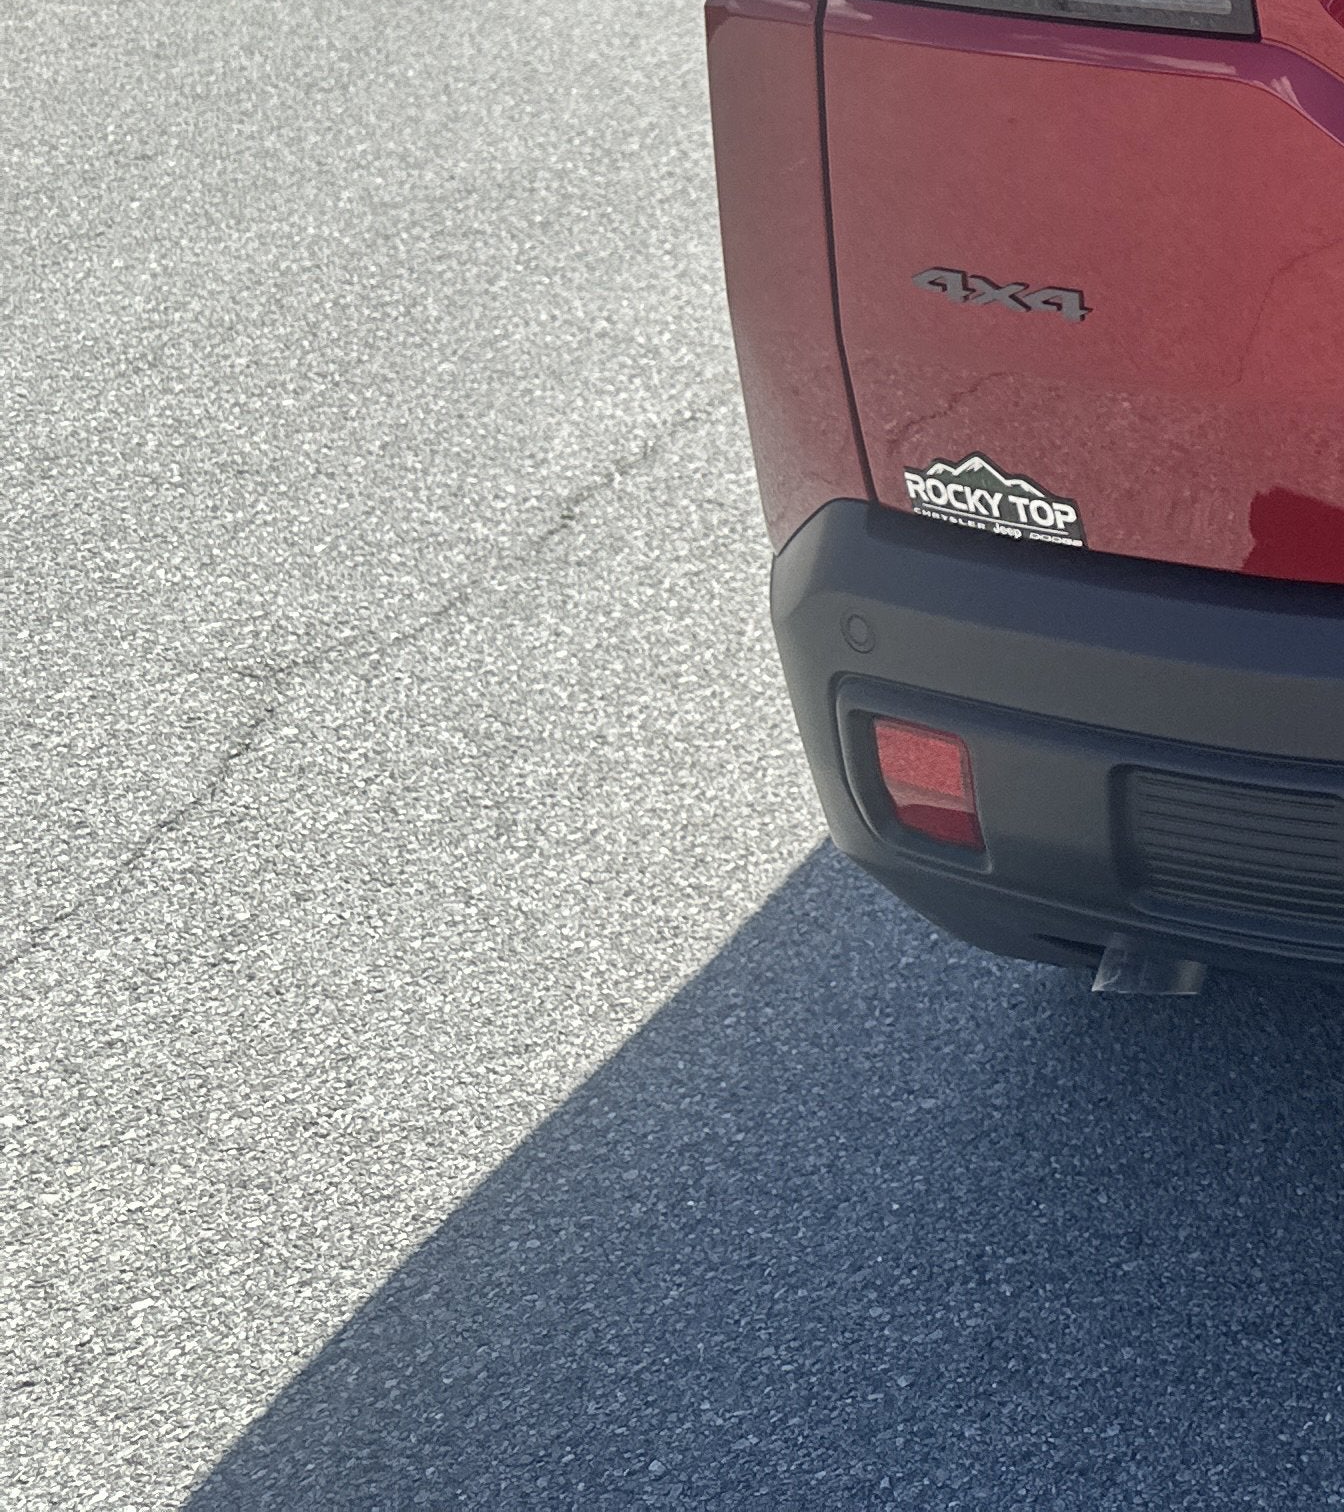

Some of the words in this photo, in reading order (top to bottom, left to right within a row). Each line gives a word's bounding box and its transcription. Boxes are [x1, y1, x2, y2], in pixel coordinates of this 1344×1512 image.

[904, 471, 1003, 518] ROCKY
[1008, 495, 1078, 530] TOP
[913, 507, 986, 530] CHRYSLER
[992, 522, 1022, 539] Jeep
[1029, 532, 1084, 547] DODGE
